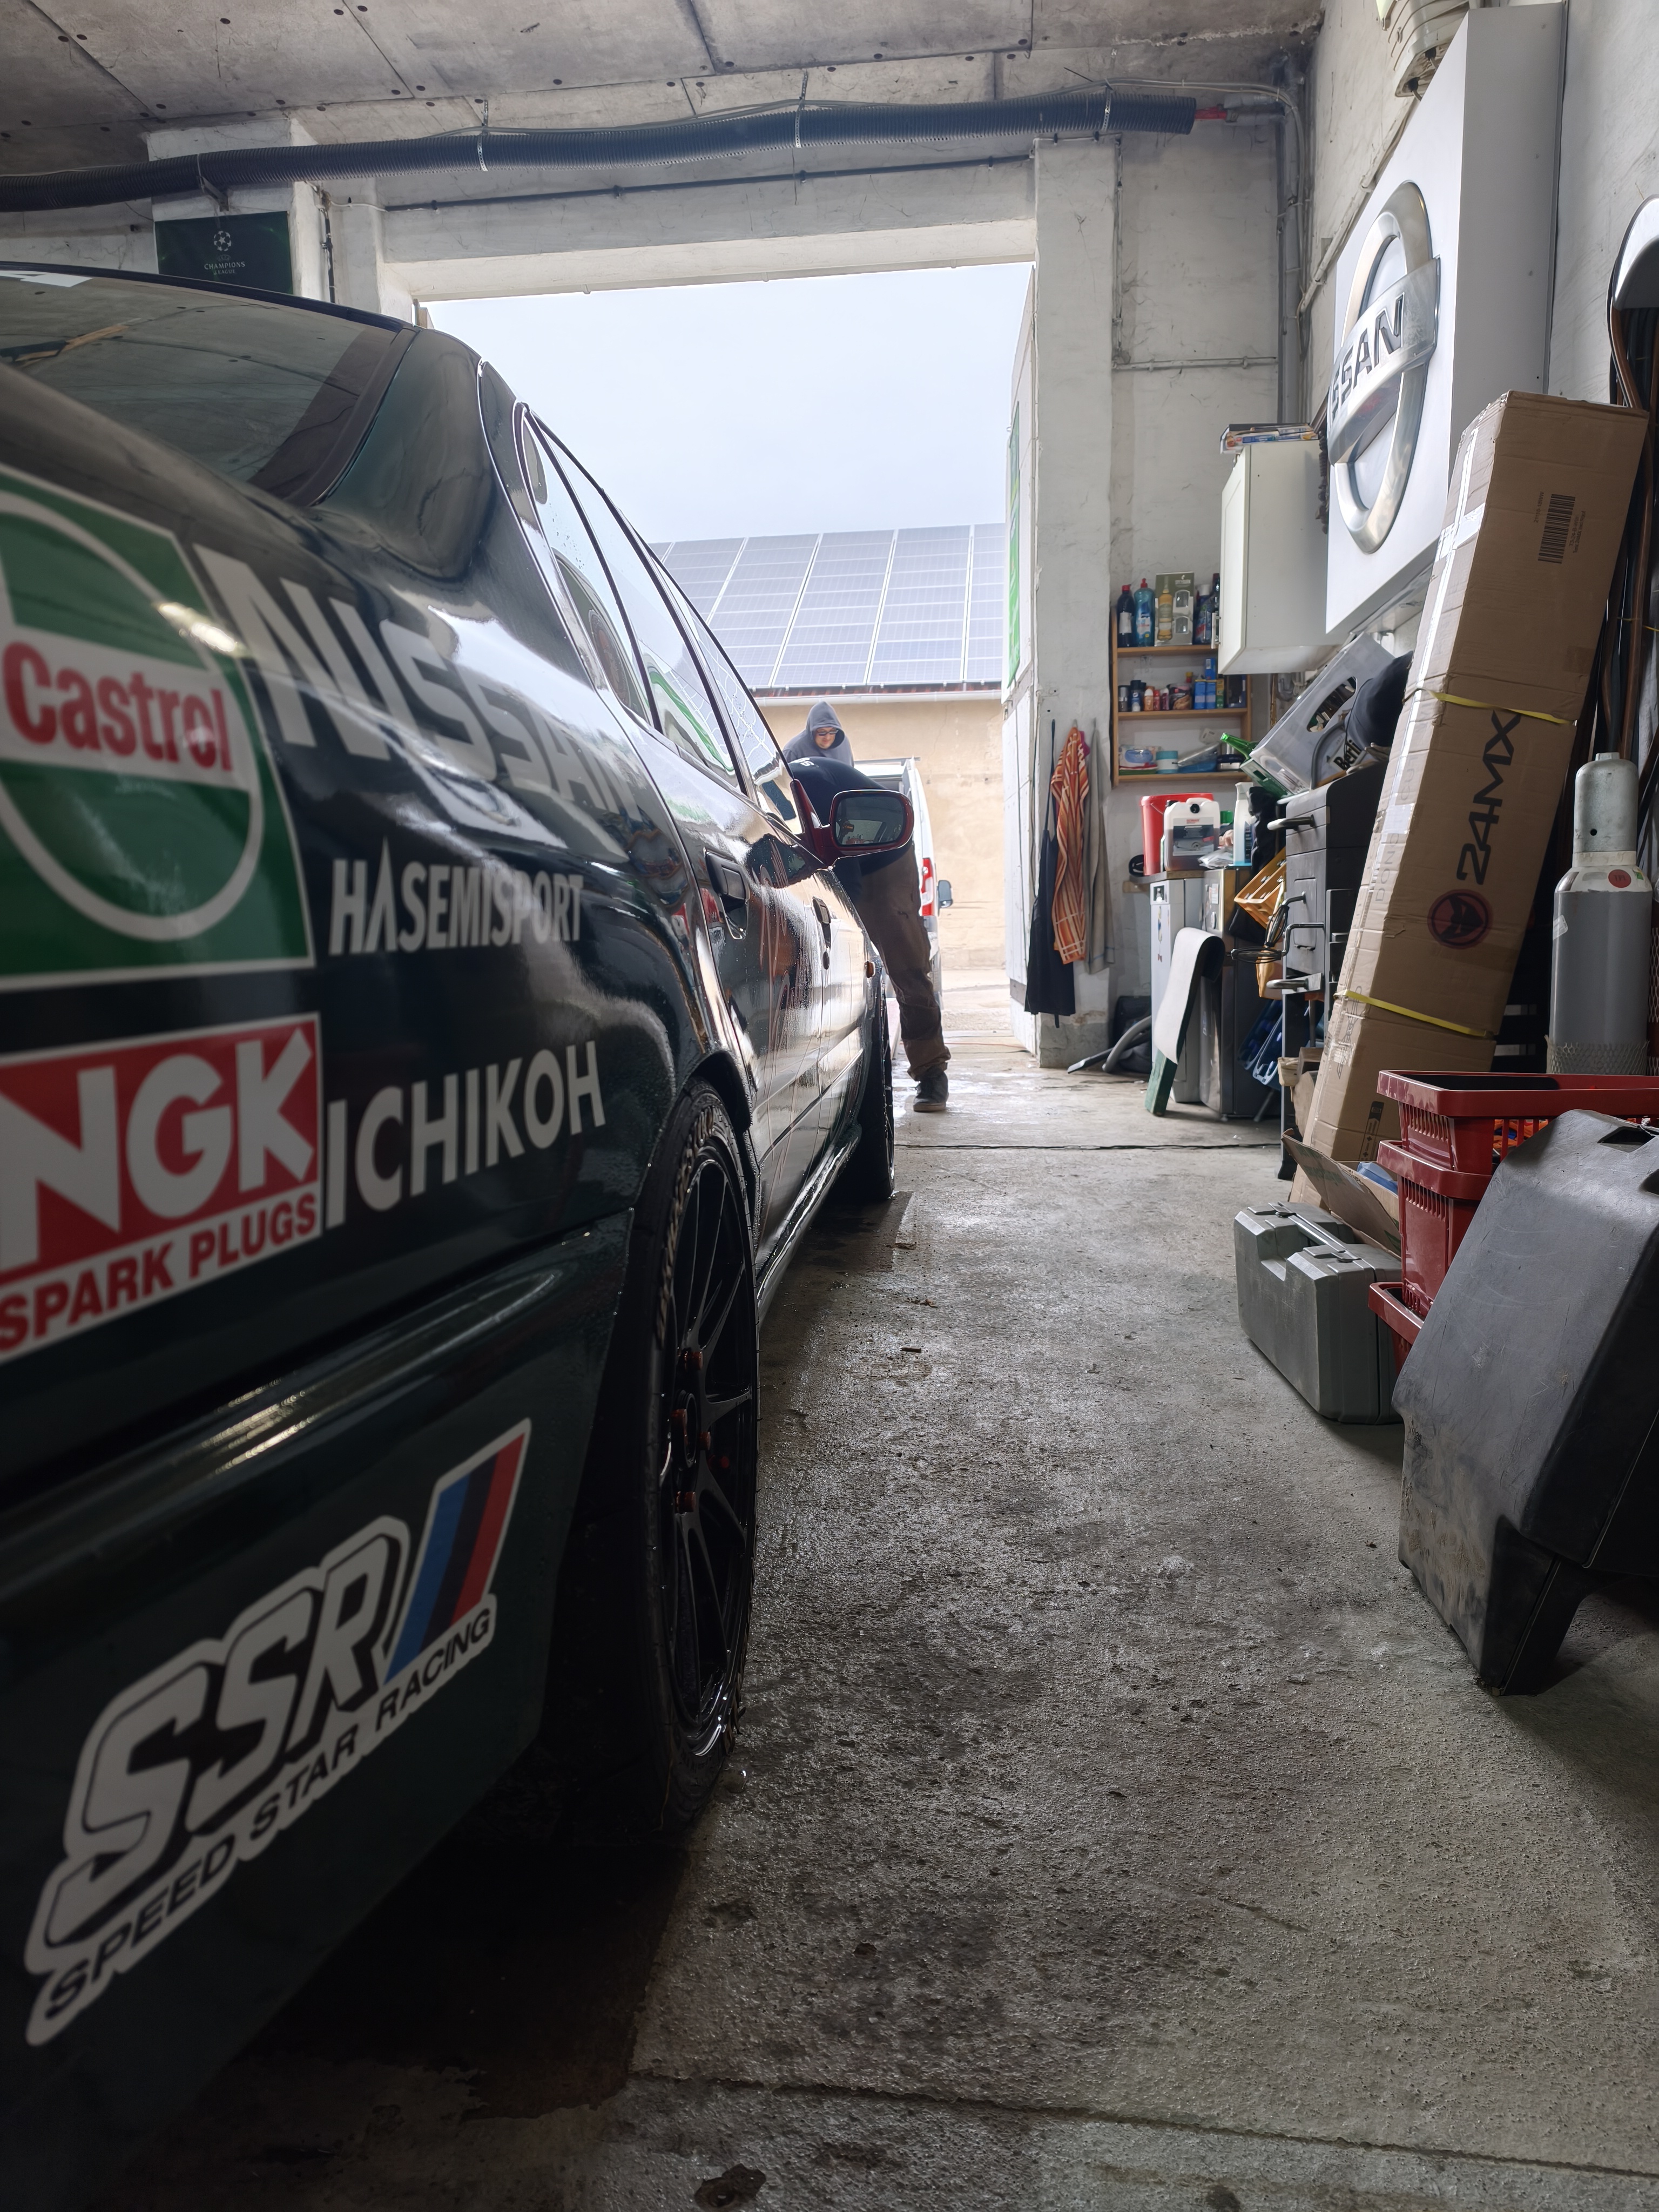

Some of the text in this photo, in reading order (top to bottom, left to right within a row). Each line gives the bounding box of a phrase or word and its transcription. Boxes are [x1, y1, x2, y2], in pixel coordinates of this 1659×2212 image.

[204, 261, 245, 269] CHAMPIONS
[2, 642, 233, 772] Castrol
[193, 543, 644, 821] NISSAN
[1456, 710, 1521, 885] 24MX
[0, 1027, 315, 1271] NGK
[326, 1041, 606, 1230] ICHIKOH
[0, 1192, 317, 1351] SPARK PLUGS
[40, 1527, 405, 1952] SSR
[44, 1607, 491, 2019] SPEED STAR RACING
